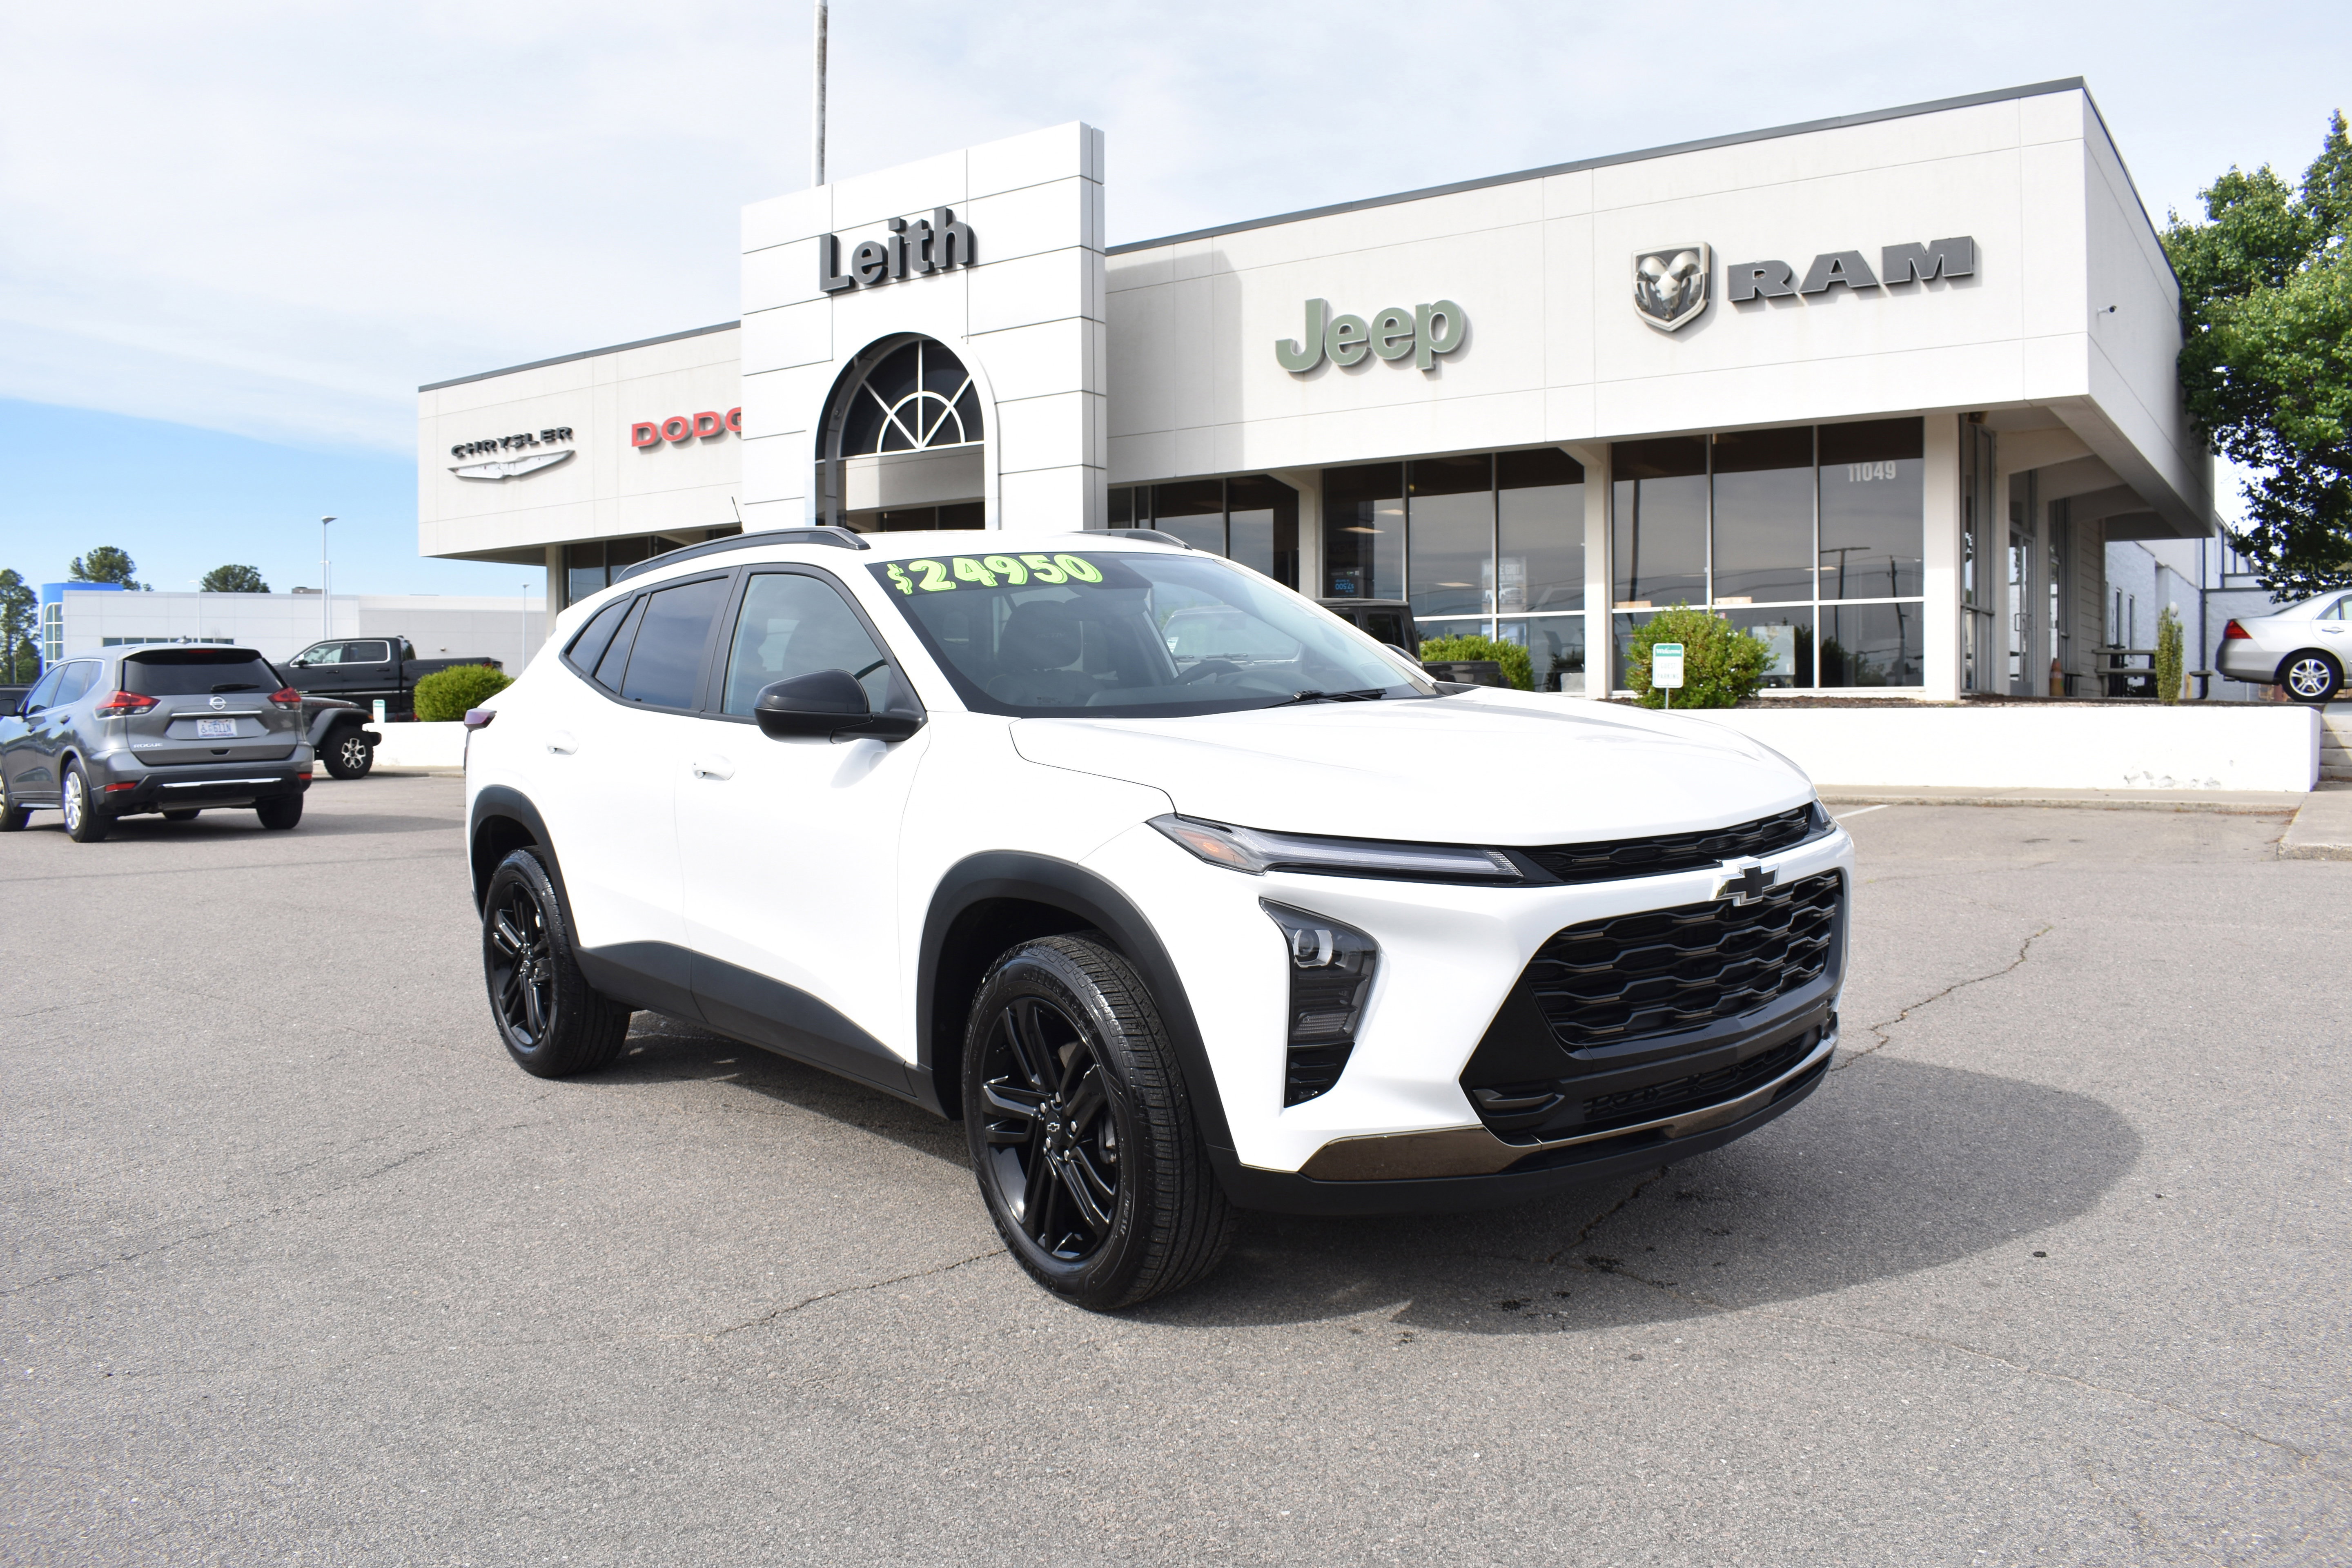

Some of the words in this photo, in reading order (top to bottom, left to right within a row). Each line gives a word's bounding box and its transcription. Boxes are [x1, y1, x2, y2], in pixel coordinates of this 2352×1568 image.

[819, 206, 974, 294] Leith
[1727, 236, 1974, 303] RAM
[1275, 298, 1467, 373] Jeep
[451, 427, 572, 458] CHRYSLER
[1848, 460, 1896, 482] 11049
[887, 554, 1103, 595] $24950
